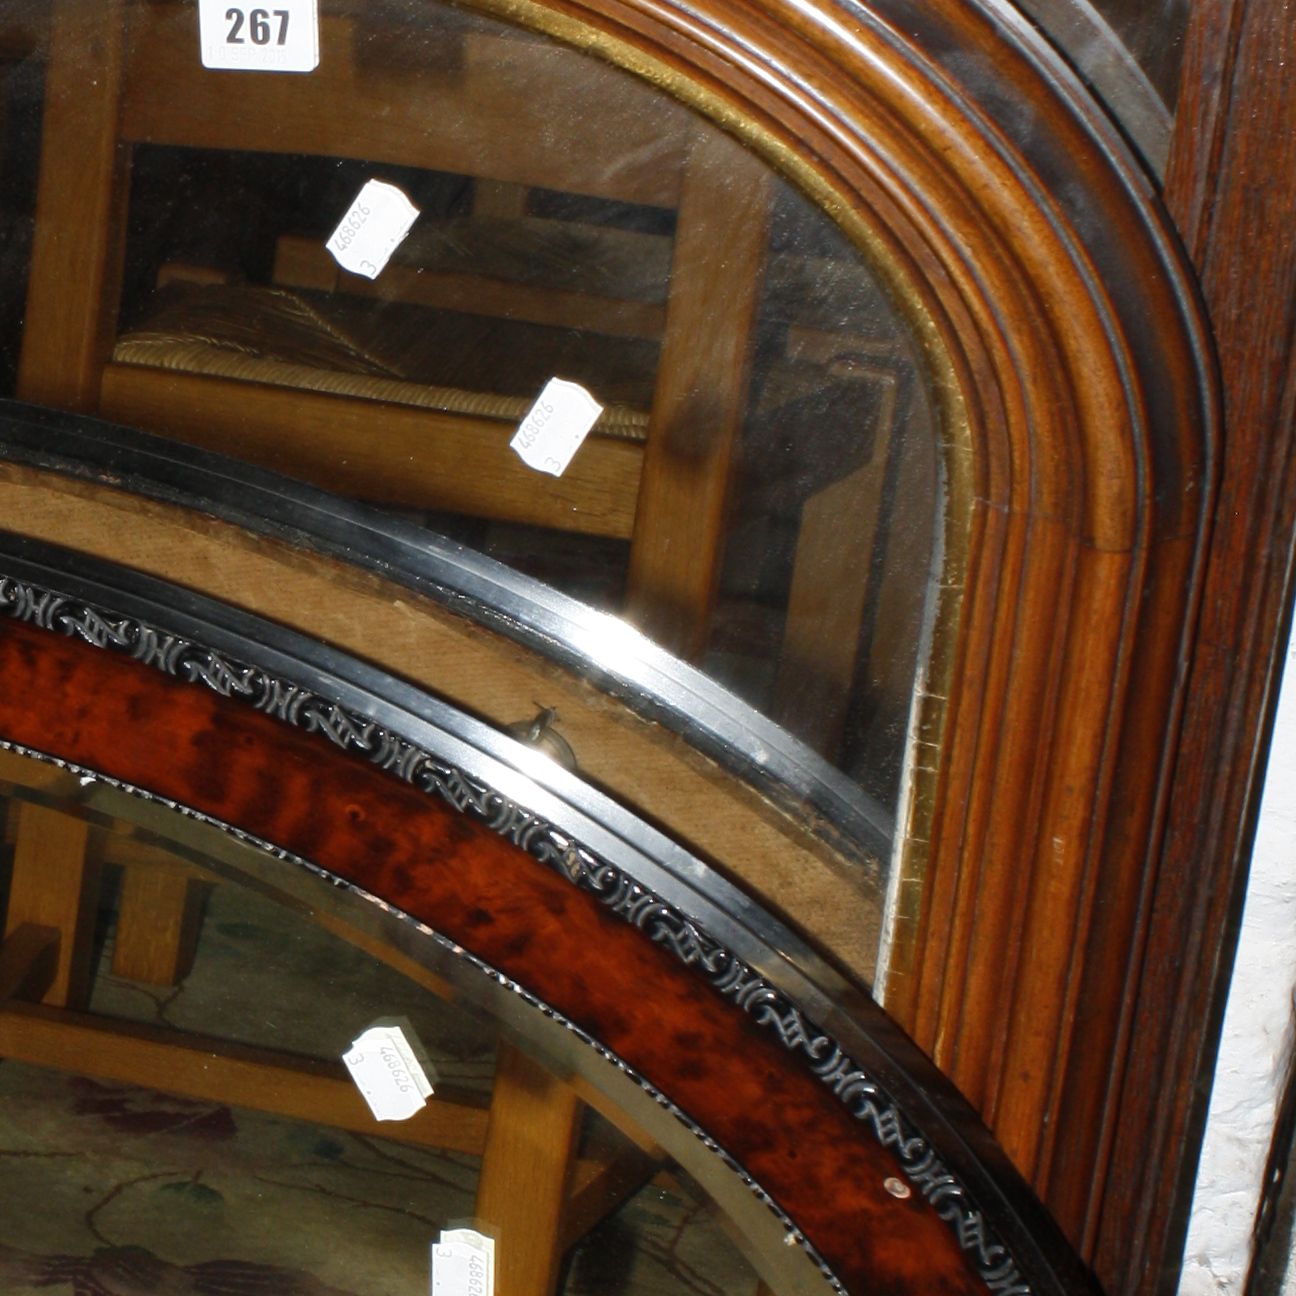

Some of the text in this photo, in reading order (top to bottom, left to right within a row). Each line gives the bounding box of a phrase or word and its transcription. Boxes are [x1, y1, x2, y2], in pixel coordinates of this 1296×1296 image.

[225, 7, 290, 46] 267
[334, 201, 370, 252] 468626
[360, 259, 377, 276] 3
[518, 400, 554, 450] 468626
[544, 456, 561, 472] 3
[348, 1053, 364, 1066] 3
[380, 1046, 415, 1093] 468626
[436, 1247, 452, 1258] 3
